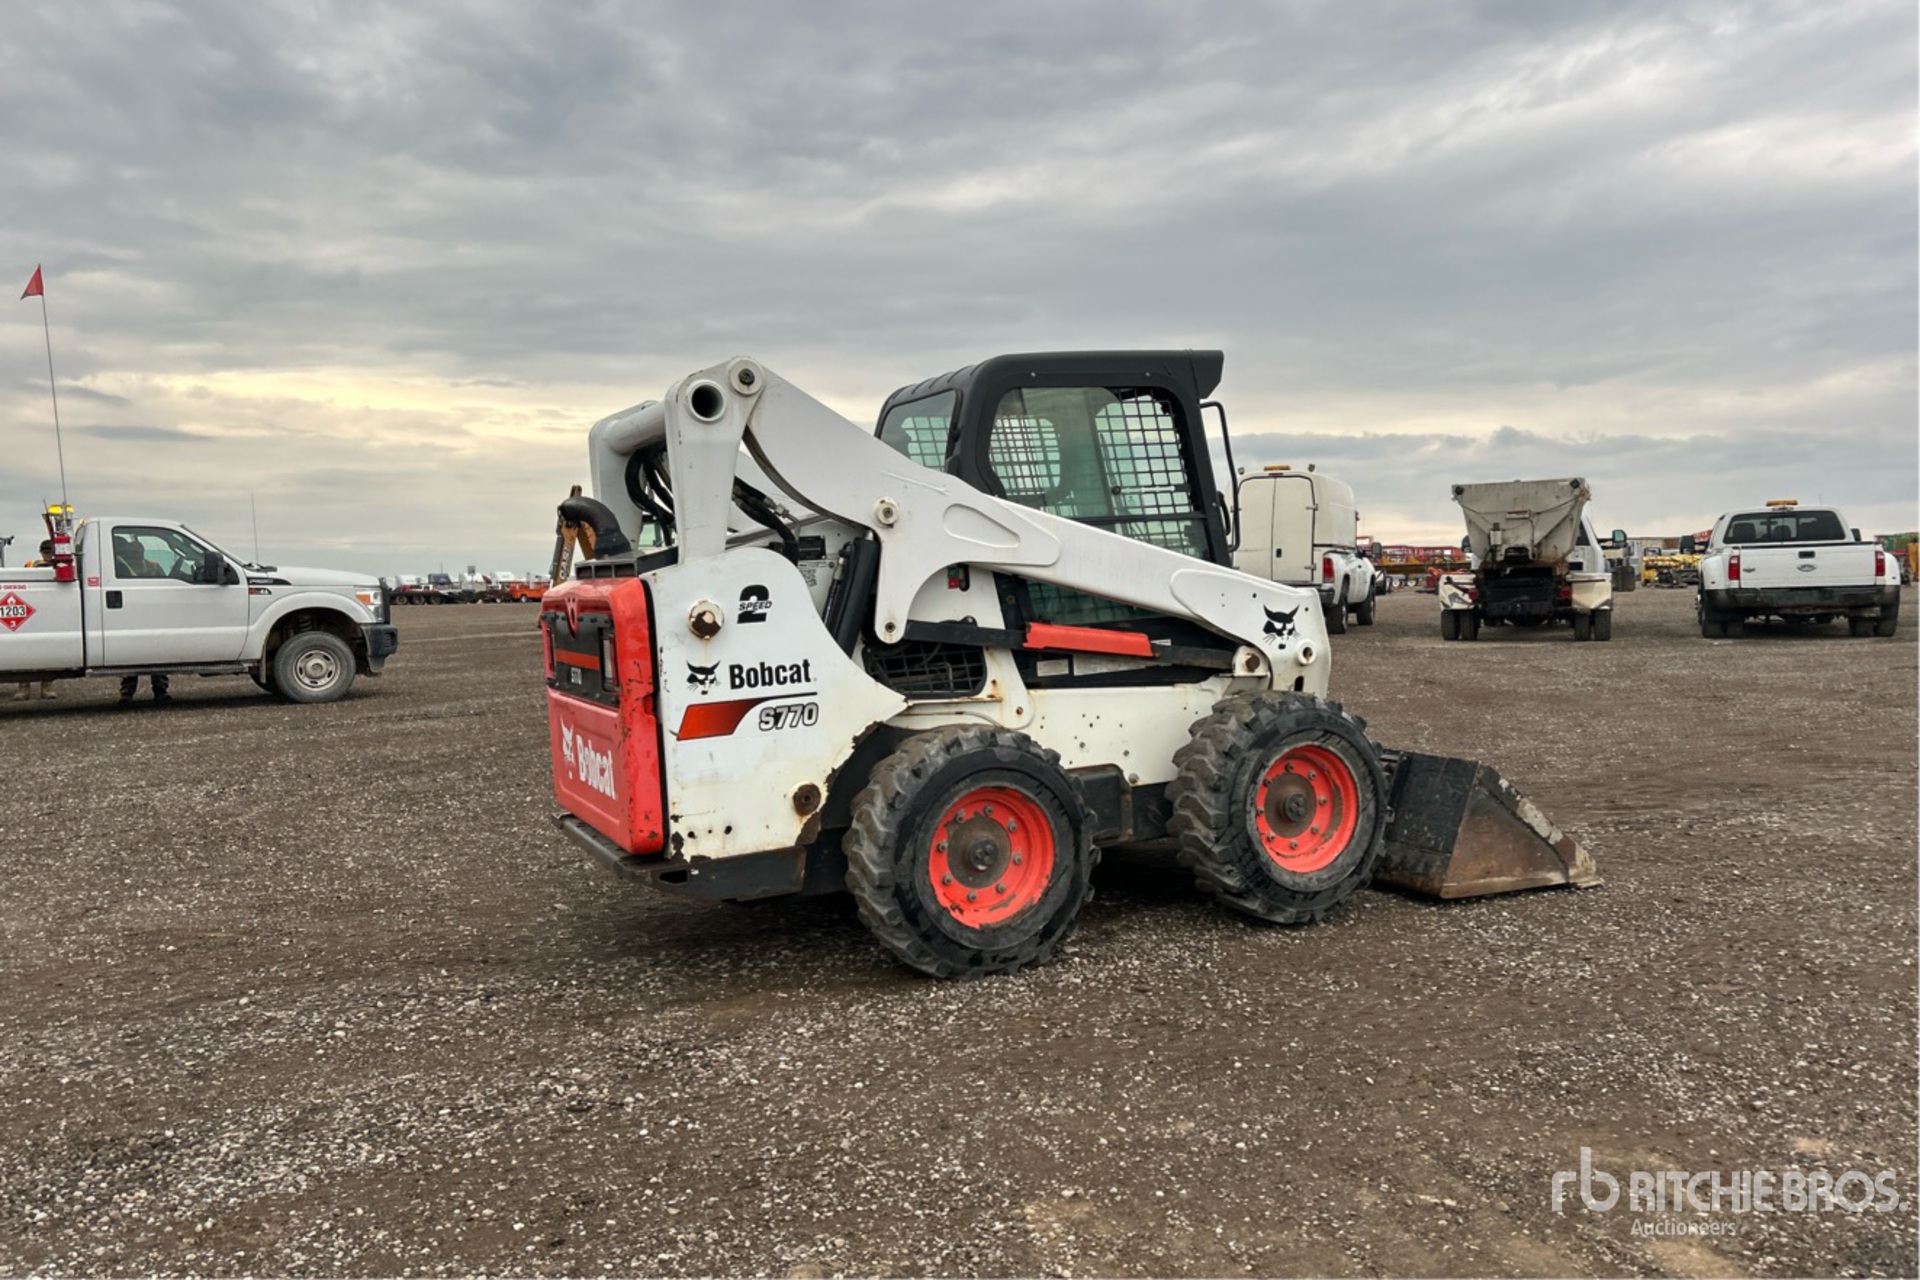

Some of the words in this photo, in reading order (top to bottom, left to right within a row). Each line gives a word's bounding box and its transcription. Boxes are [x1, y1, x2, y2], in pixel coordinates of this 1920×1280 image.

[0, 606, 25, 616] 1203
[737, 584, 769, 624] 2
[739, 600, 772, 611] SPEED
[10, 620, 16, 628] 3
[729, 659, 811, 690] Bobcat
[758, 702, 819, 731] S770
[575, 734, 616, 800] Bobcat
